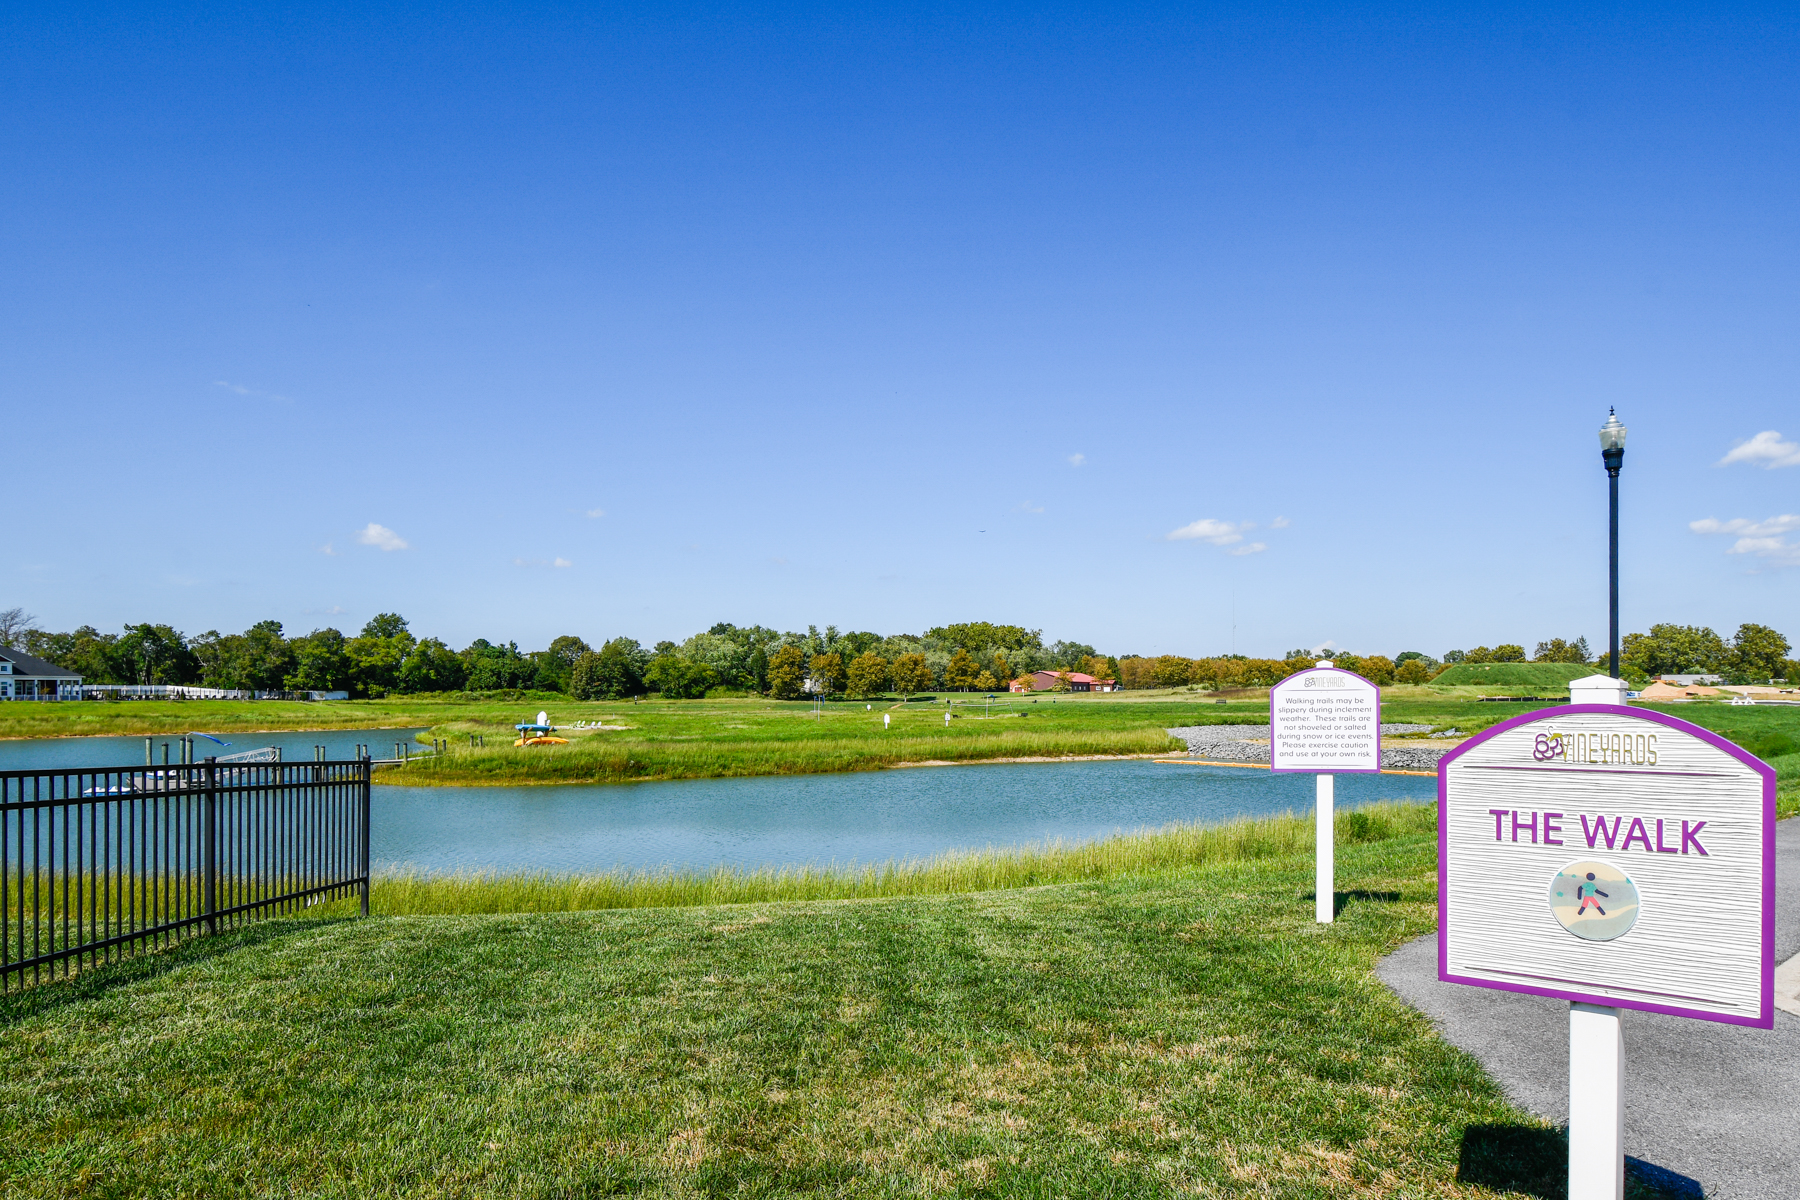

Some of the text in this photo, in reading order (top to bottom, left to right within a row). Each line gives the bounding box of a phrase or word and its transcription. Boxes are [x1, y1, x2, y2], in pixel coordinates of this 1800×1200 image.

[1560, 732, 1657, 764] VINEYARDS
[1489, 809, 1709, 856] THE WALK
